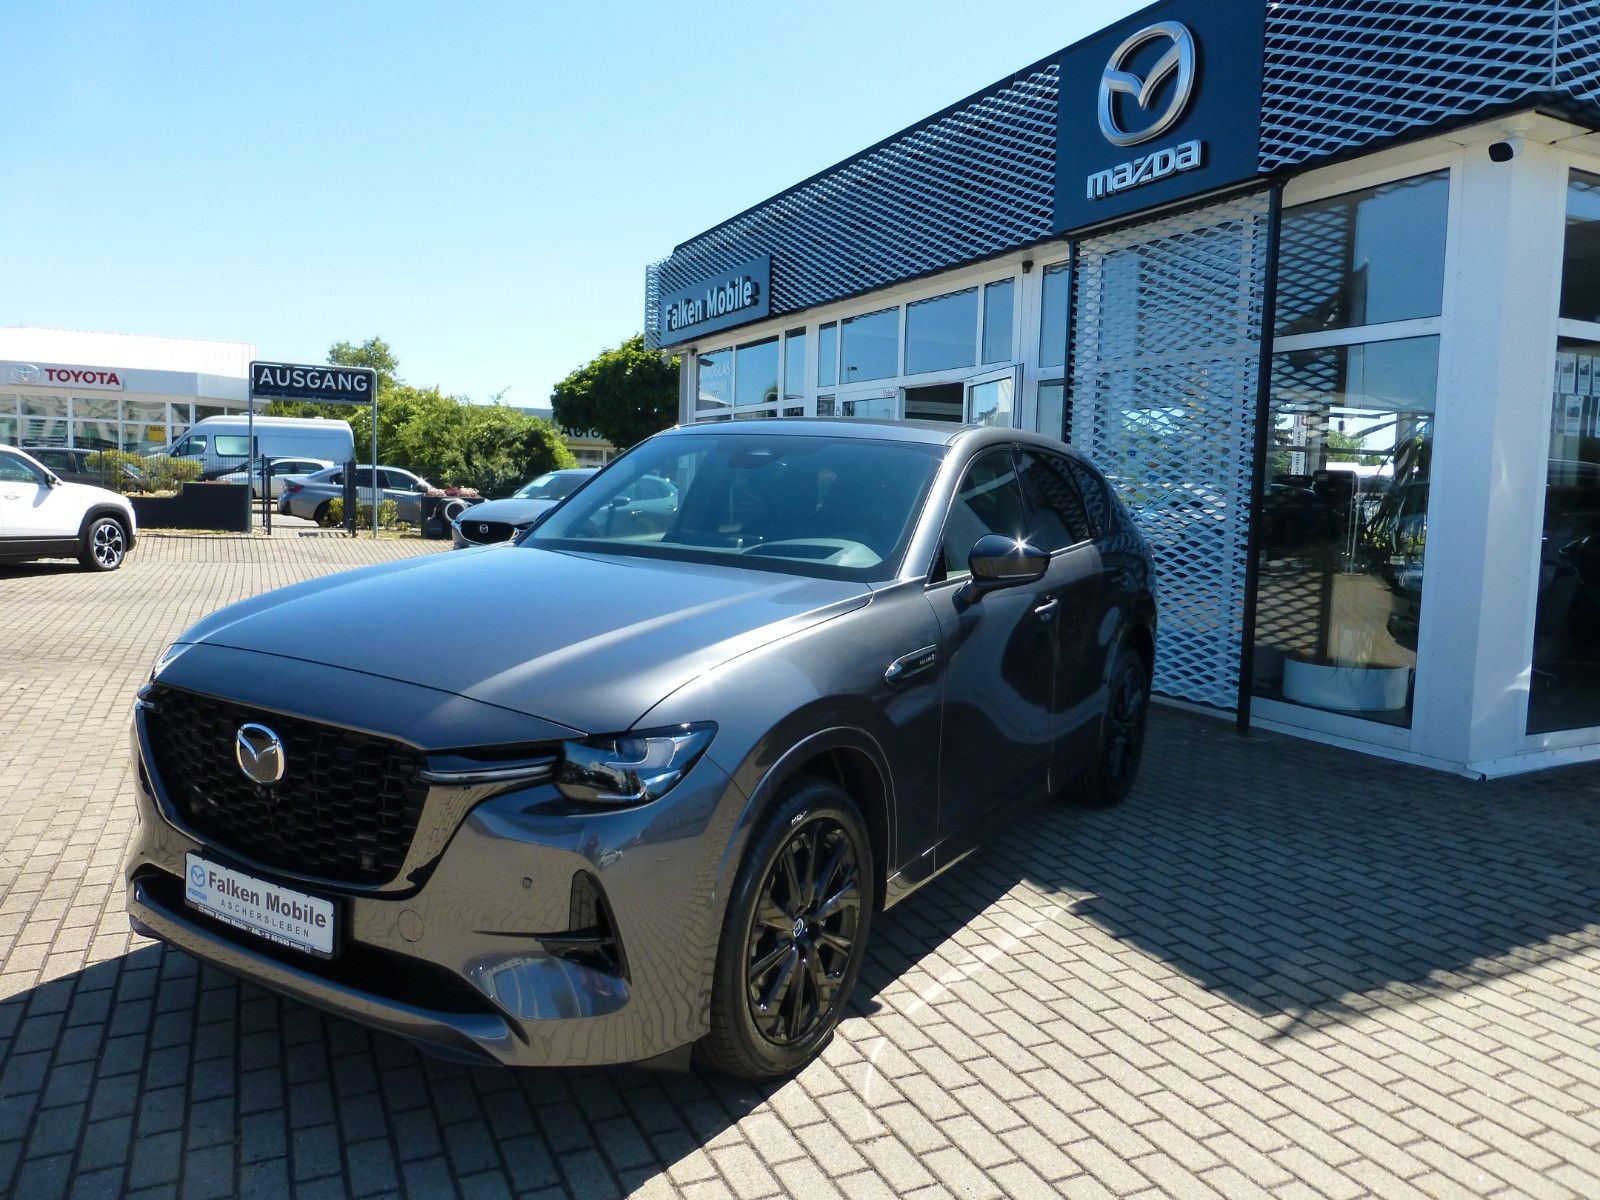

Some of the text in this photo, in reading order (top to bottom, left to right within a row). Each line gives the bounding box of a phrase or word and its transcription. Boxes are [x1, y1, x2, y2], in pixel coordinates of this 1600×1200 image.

[665, 276, 752, 332] Falken Mobile
[45, 368, 121, 386] TOYOTA
[259, 368, 368, 392] AUSGANG
[208, 871, 327, 928] Falken Mobile
[220, 899, 309, 938] ASCHERSLEBEN
